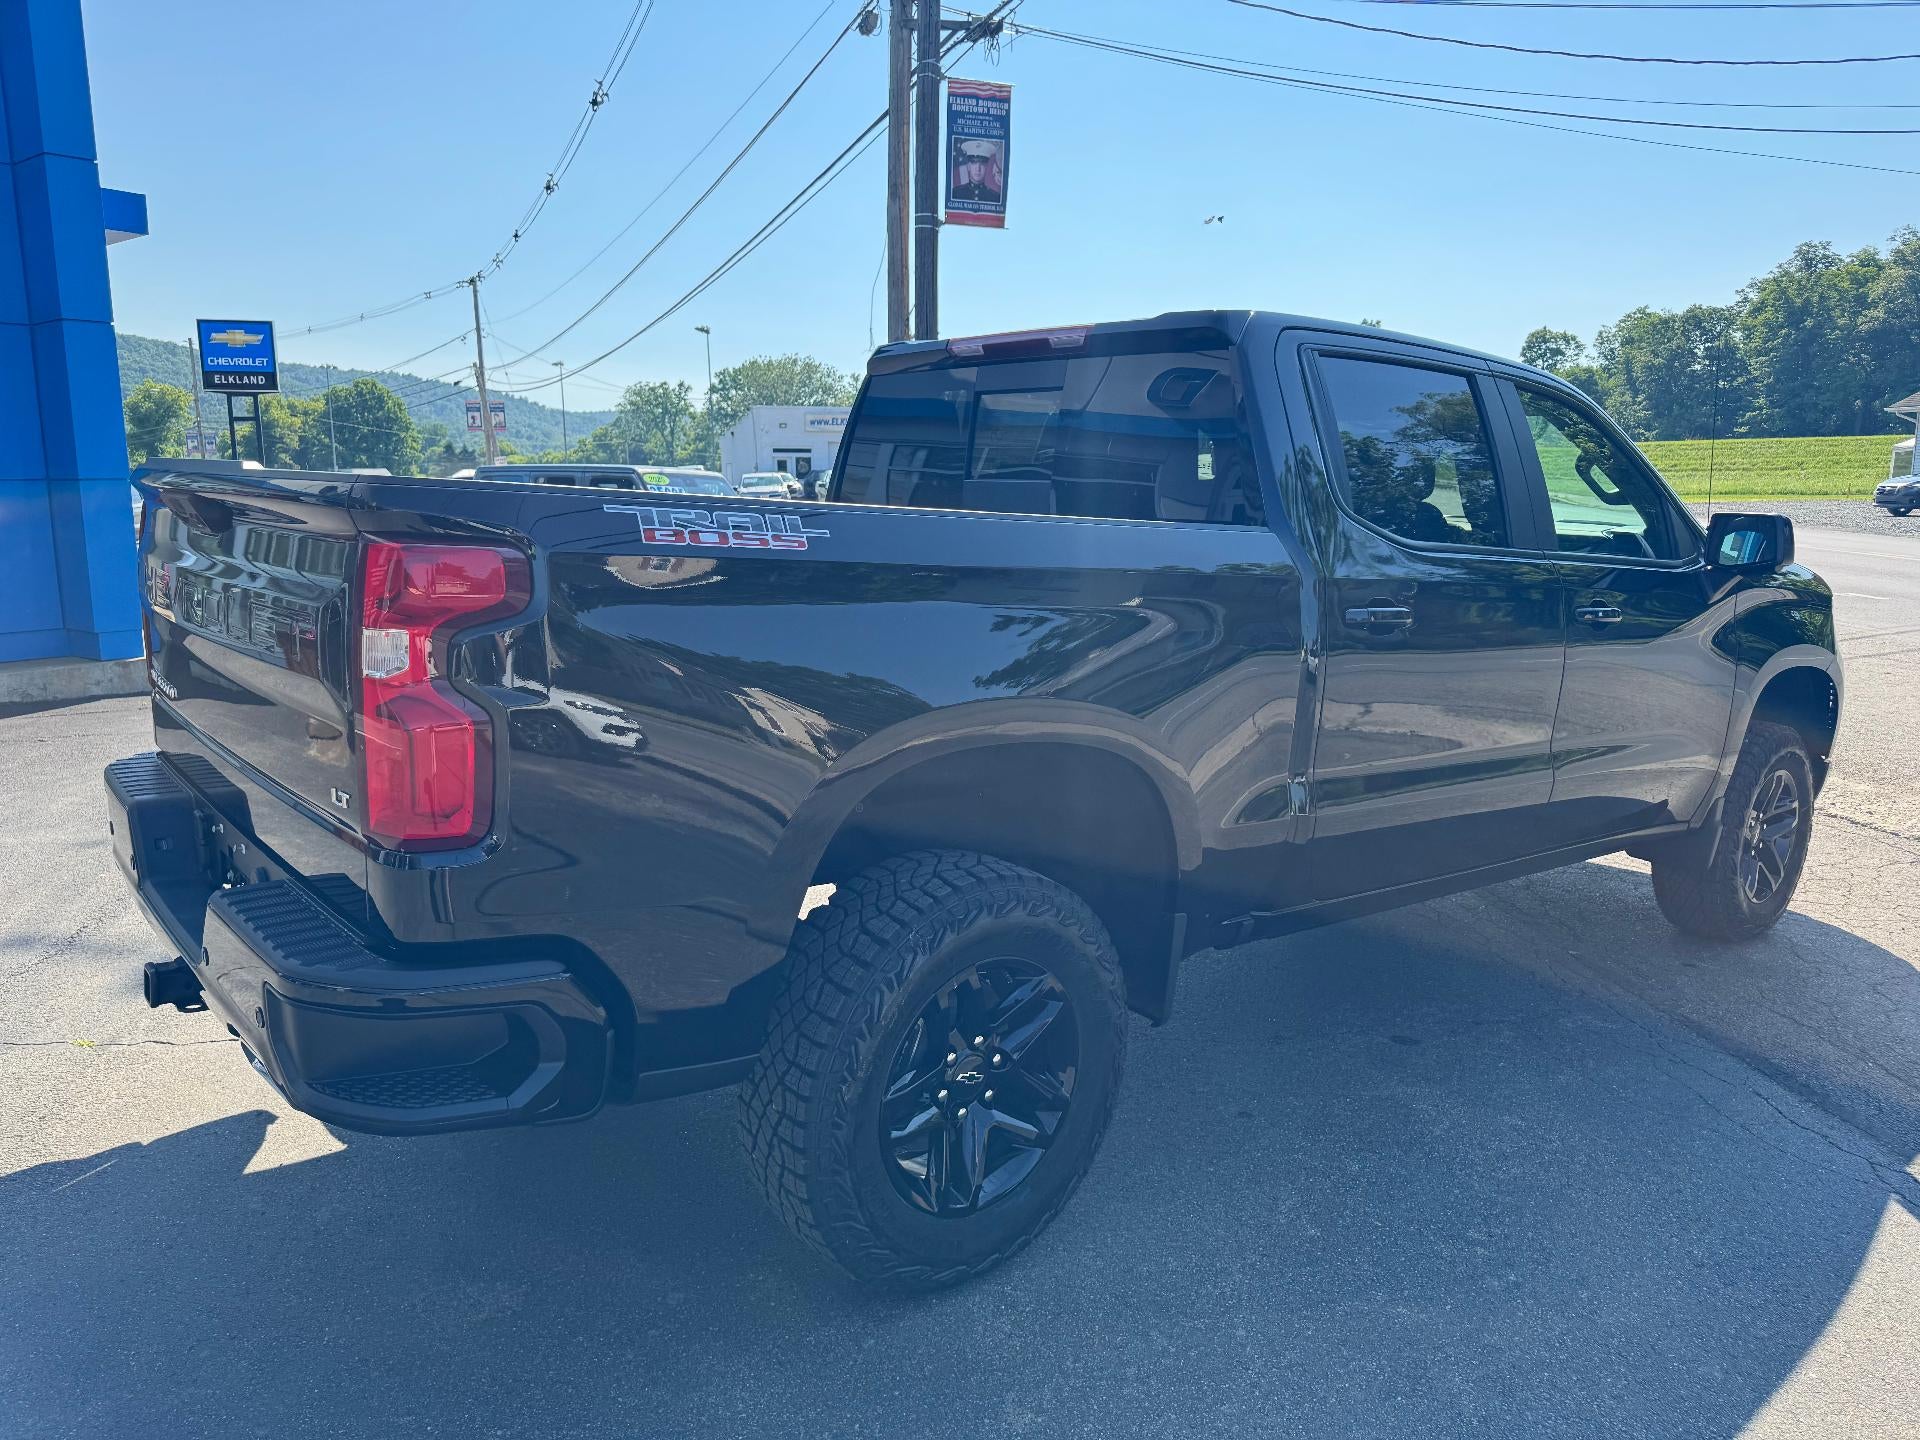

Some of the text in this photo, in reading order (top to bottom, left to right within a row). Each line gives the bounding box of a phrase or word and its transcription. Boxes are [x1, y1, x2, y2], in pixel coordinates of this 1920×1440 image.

[952, 103, 1006, 116] HOMETOWN HERO
[978, 99, 1008, 109] BOROUGH
[963, 127, 986, 135] MARINE
[207, 356, 269, 367] CHEVROLET
[214, 374, 266, 385] ELKLAND
[603, 504, 830, 537] TRAIL
[641, 526, 808, 550] BOSS
[330, 787, 350, 809] LT
